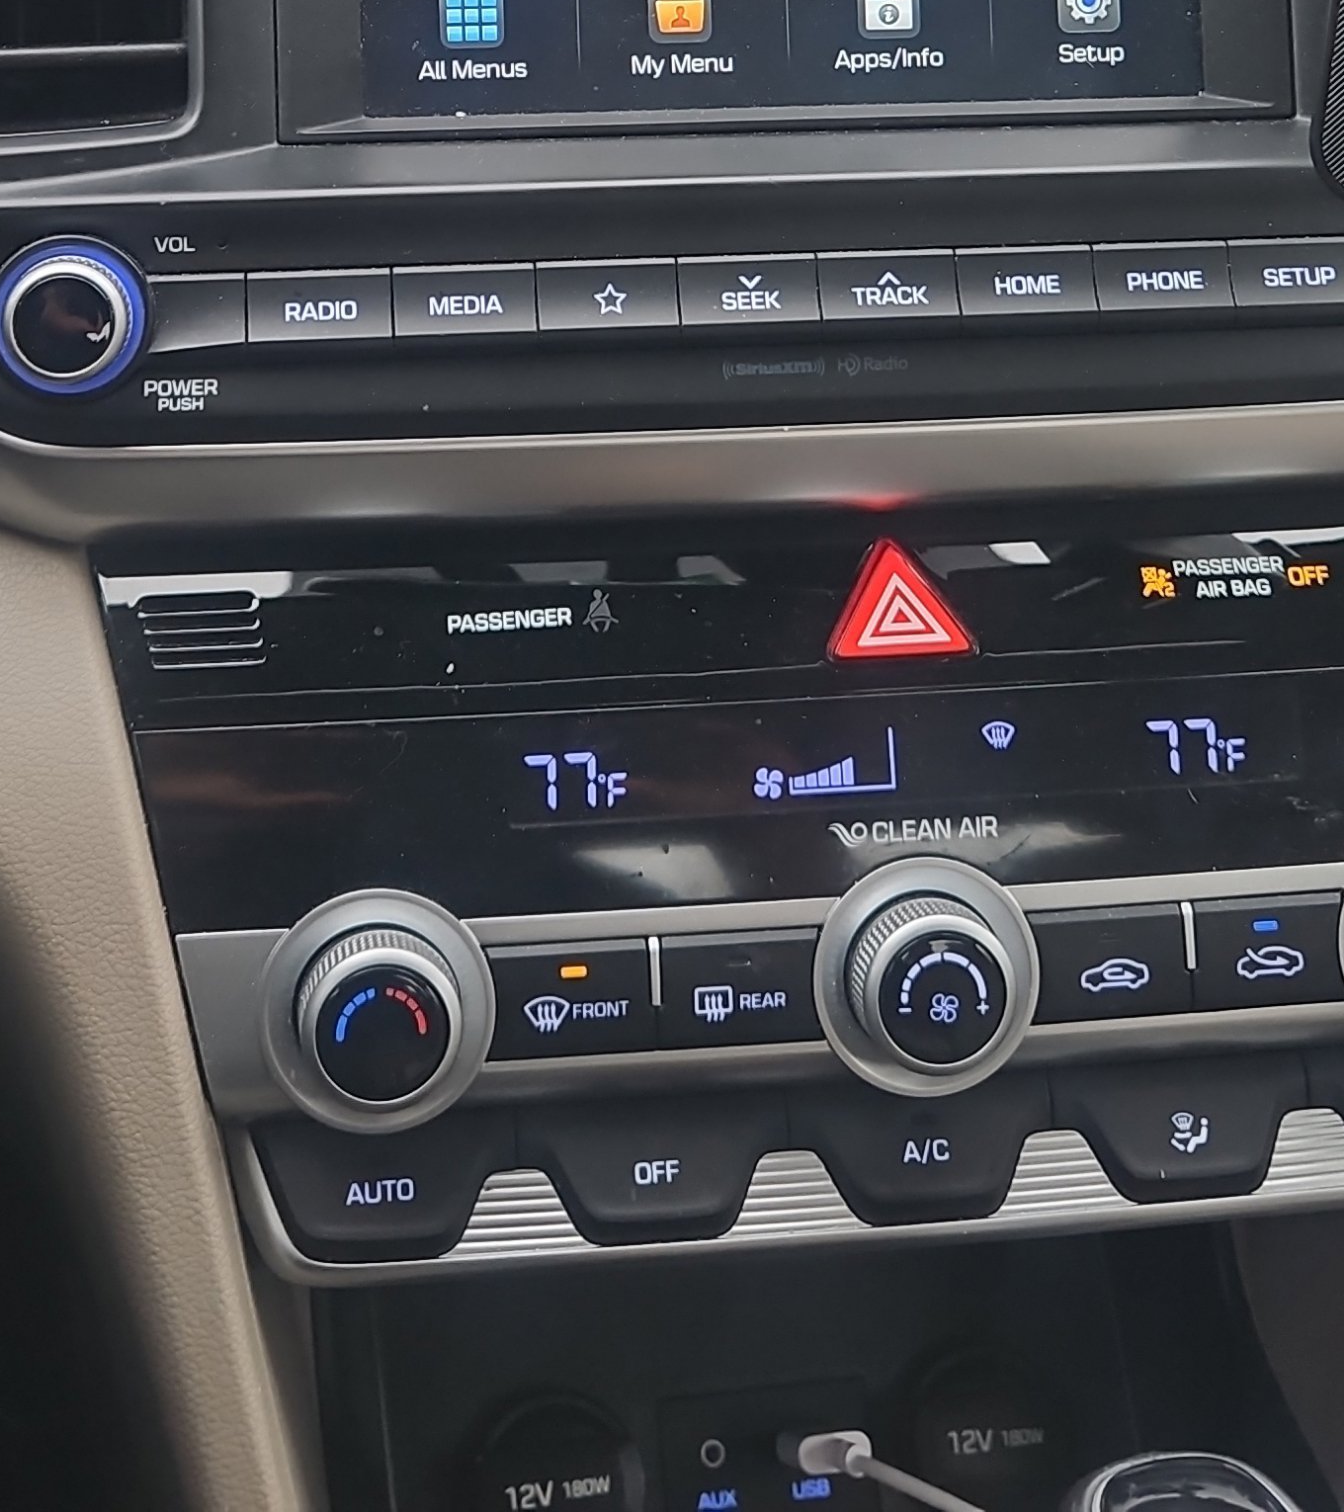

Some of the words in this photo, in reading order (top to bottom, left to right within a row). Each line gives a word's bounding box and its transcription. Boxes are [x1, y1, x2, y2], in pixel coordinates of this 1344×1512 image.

[834, 47, 944, 74] Apps/Info
[1058, 43, 1125, 66] Setup
[418, 59, 448, 82] All
[453, 58, 529, 81] Menus
[631, 54, 666, 79] My
[670, 53, 734, 74] Menu
[154, 236, 196, 253] VOL
[994, 274, 1062, 296] HOME
[1126, 270, 1205, 292] PHONE
[1263, 266, 1336, 287] SETUP
[429, 294, 504, 316] MEDIA
[721, 290, 782, 311] SEEK
[851, 285, 930, 306] TRACK
[284, 300, 358, 322] RADIO
[143, 378, 219, 398] POWER
[157, 396, 204, 412] PUSH
[1171, 555, 1286, 580] PASSENGER
[1287, 565, 1329, 587] OFF
[1196, 580, 1228, 599] AIR
[1230, 578, 1272, 597] BAG
[447, 607, 572, 634] PASSENGER
[872, 818, 952, 844] CLEAN
[958, 815, 999, 842] AIR
[571, 999, 630, 1021] FRONT
[739, 991, 786, 1010] REAR
[903, 1138, 950, 1164] A/C
[634, 1159, 680, 1185] OFF
[345, 1178, 414, 1206] AUTO
[947, 1429, 993, 1455] 12V
[1000, 1428, 1043, 1447] 180W
[505, 1480, 554, 1510] 12V
[562, 1474, 611, 1498] 180W
[792, 1478, 831, 1500] USB
[698, 1490, 737, 1511] AUX
